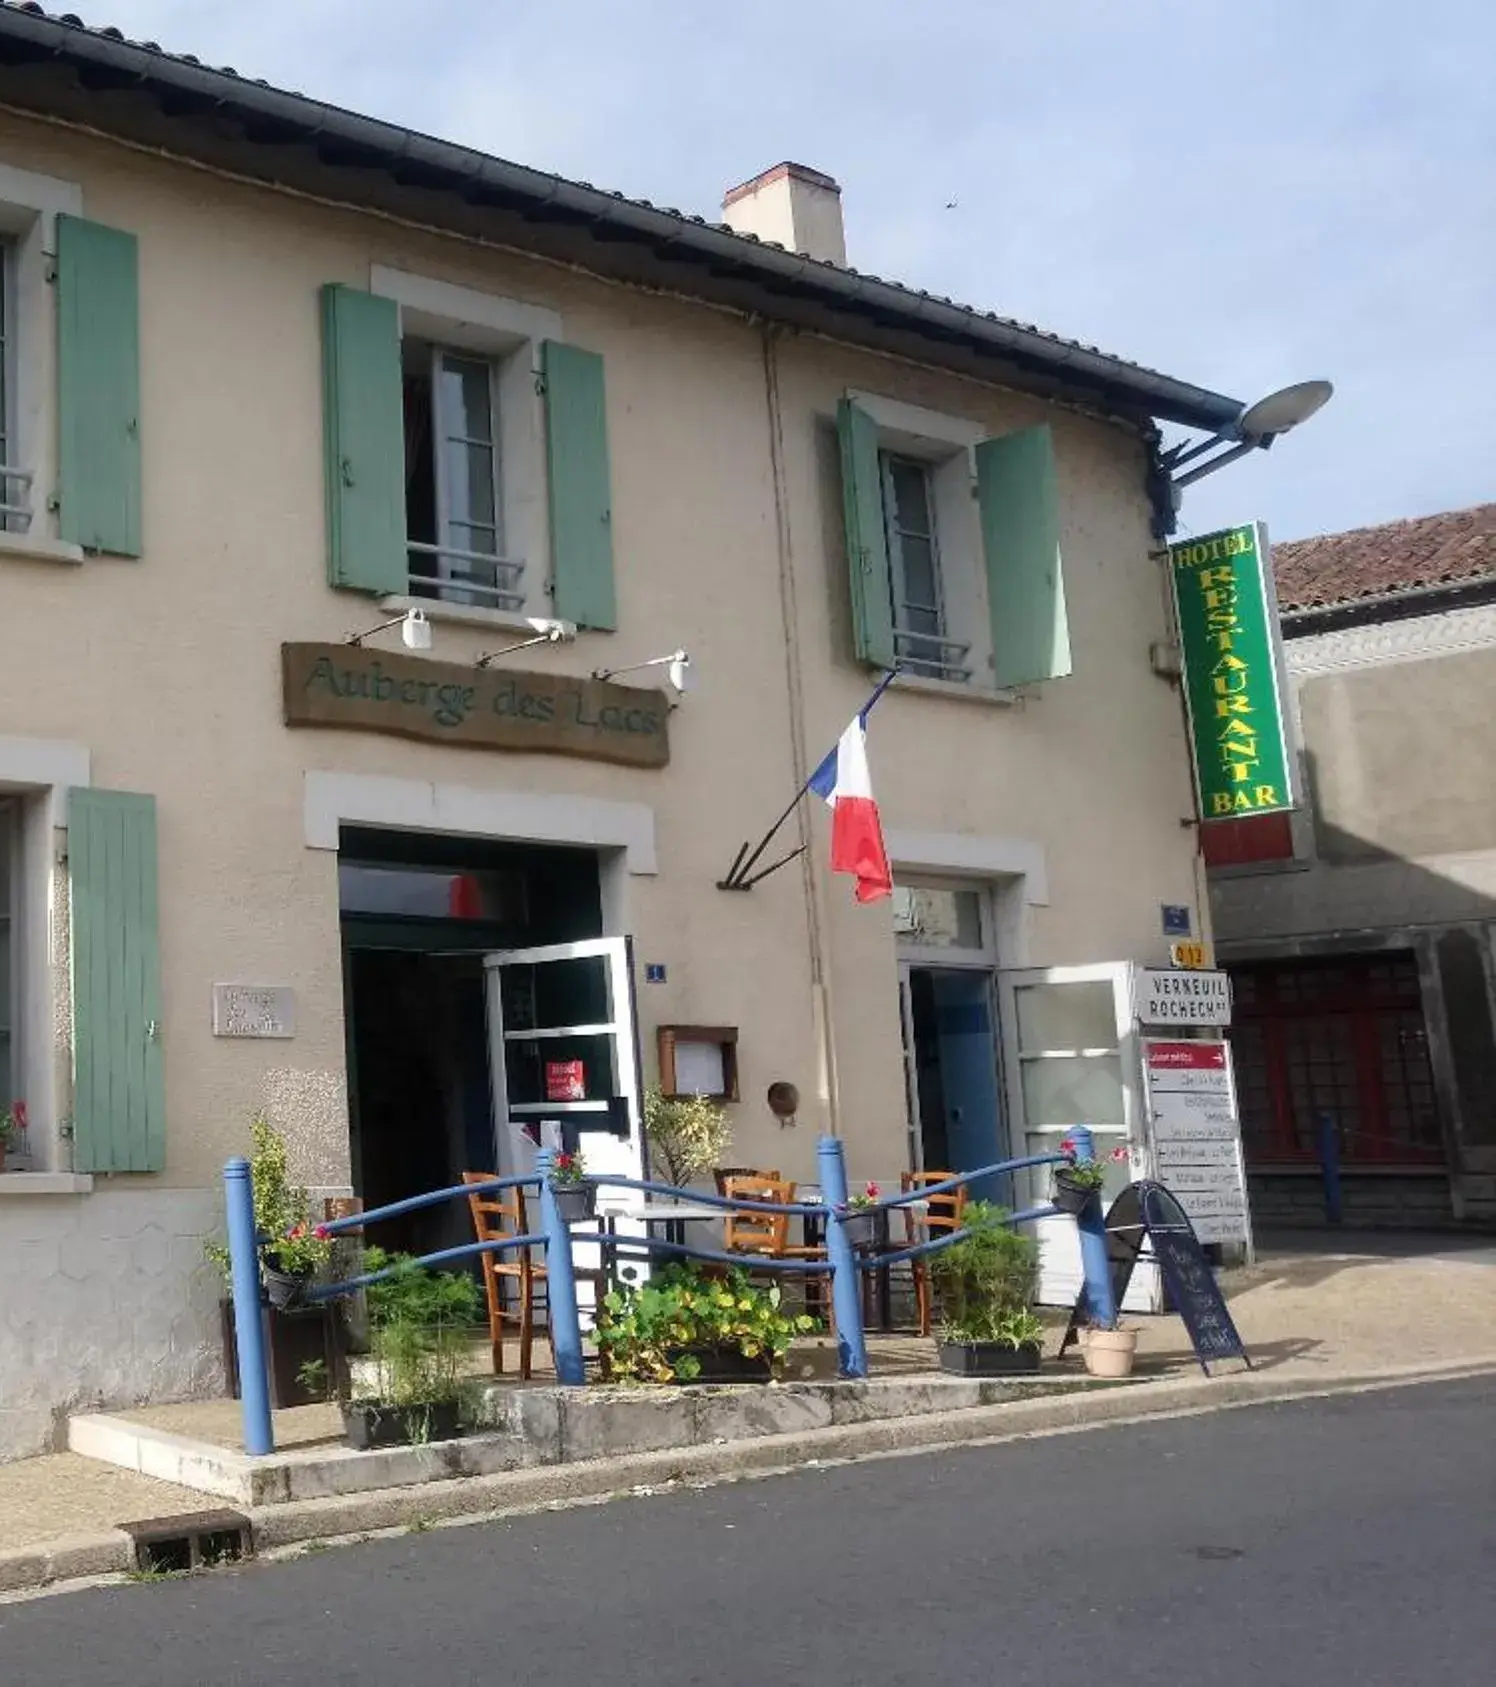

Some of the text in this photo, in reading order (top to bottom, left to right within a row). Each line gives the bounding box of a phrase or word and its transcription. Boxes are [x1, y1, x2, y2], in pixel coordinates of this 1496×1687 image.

[1176, 531, 1253, 568] HOTEL
[1199, 565, 1260, 782] RESTAURANT
[305, 657, 659, 735] Auberge des Lacs
[1212, 785, 1279, 814] BAR
[1152, 977, 1226, 996] VERNEUIL
